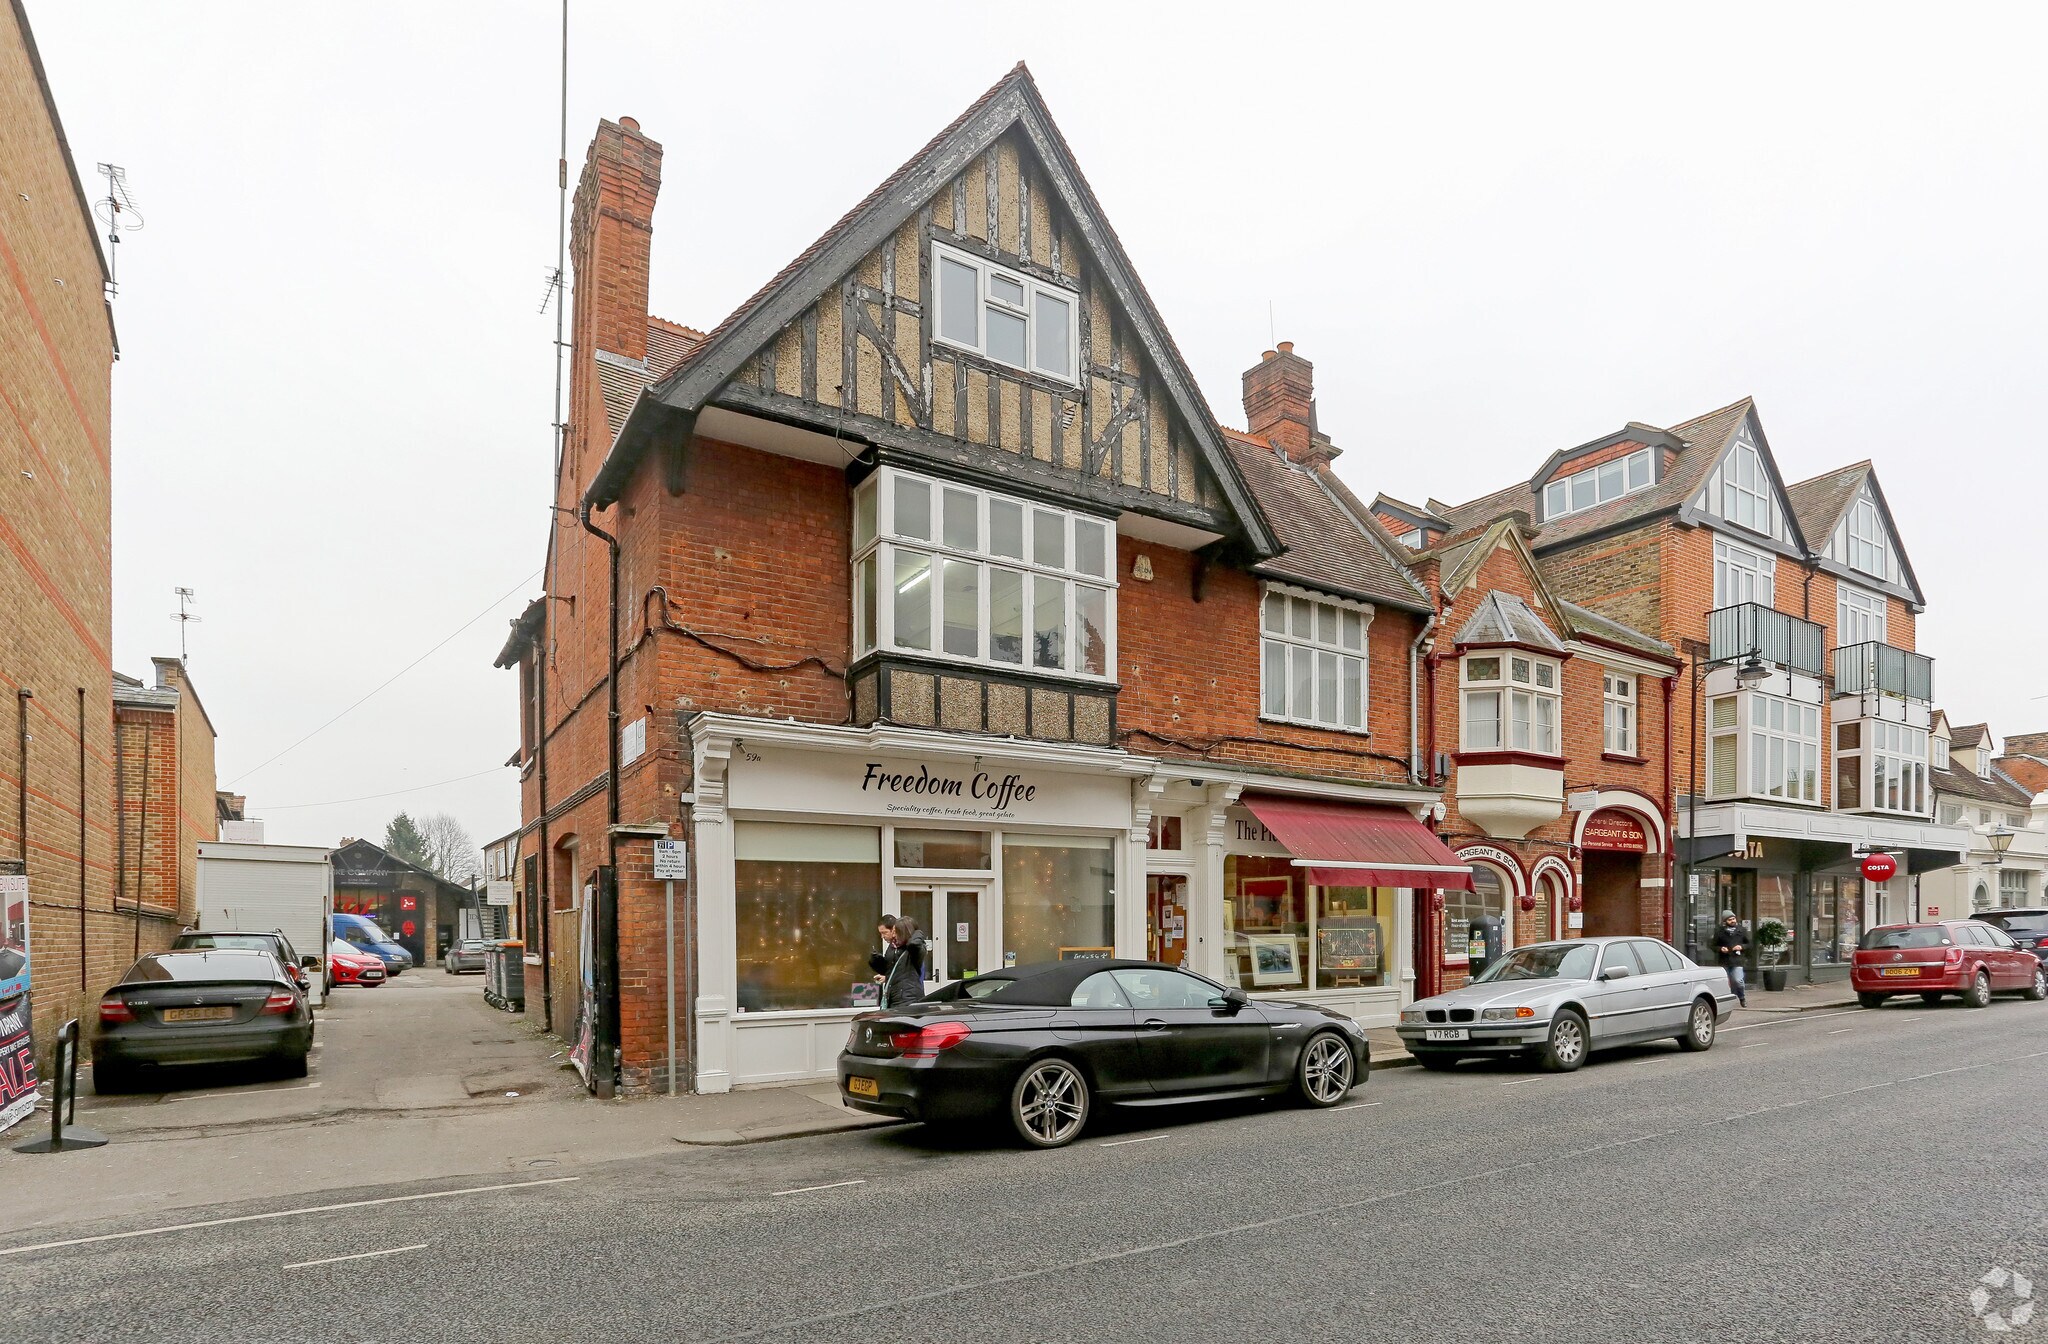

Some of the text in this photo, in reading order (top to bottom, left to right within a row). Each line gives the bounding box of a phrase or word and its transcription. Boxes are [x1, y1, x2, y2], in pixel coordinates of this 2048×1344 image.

[745, 752, 761, 762] 59a
[861, 763, 1036, 810] Freedom Coffee
[886, 803, 1015, 819] Speciality coffee, fresh food, great gelato
[1608, 818, 1633, 827] Directors
[1235, 819, 1257, 841] The
[1585, 827, 1643, 839] SARGEANT & SON
[1496, 851, 1501, 860] &
[1503, 855, 1518, 873] SON
[1475, 930, 1482, 939] P
[1432, 1030, 1460, 1039] V7 RGB
